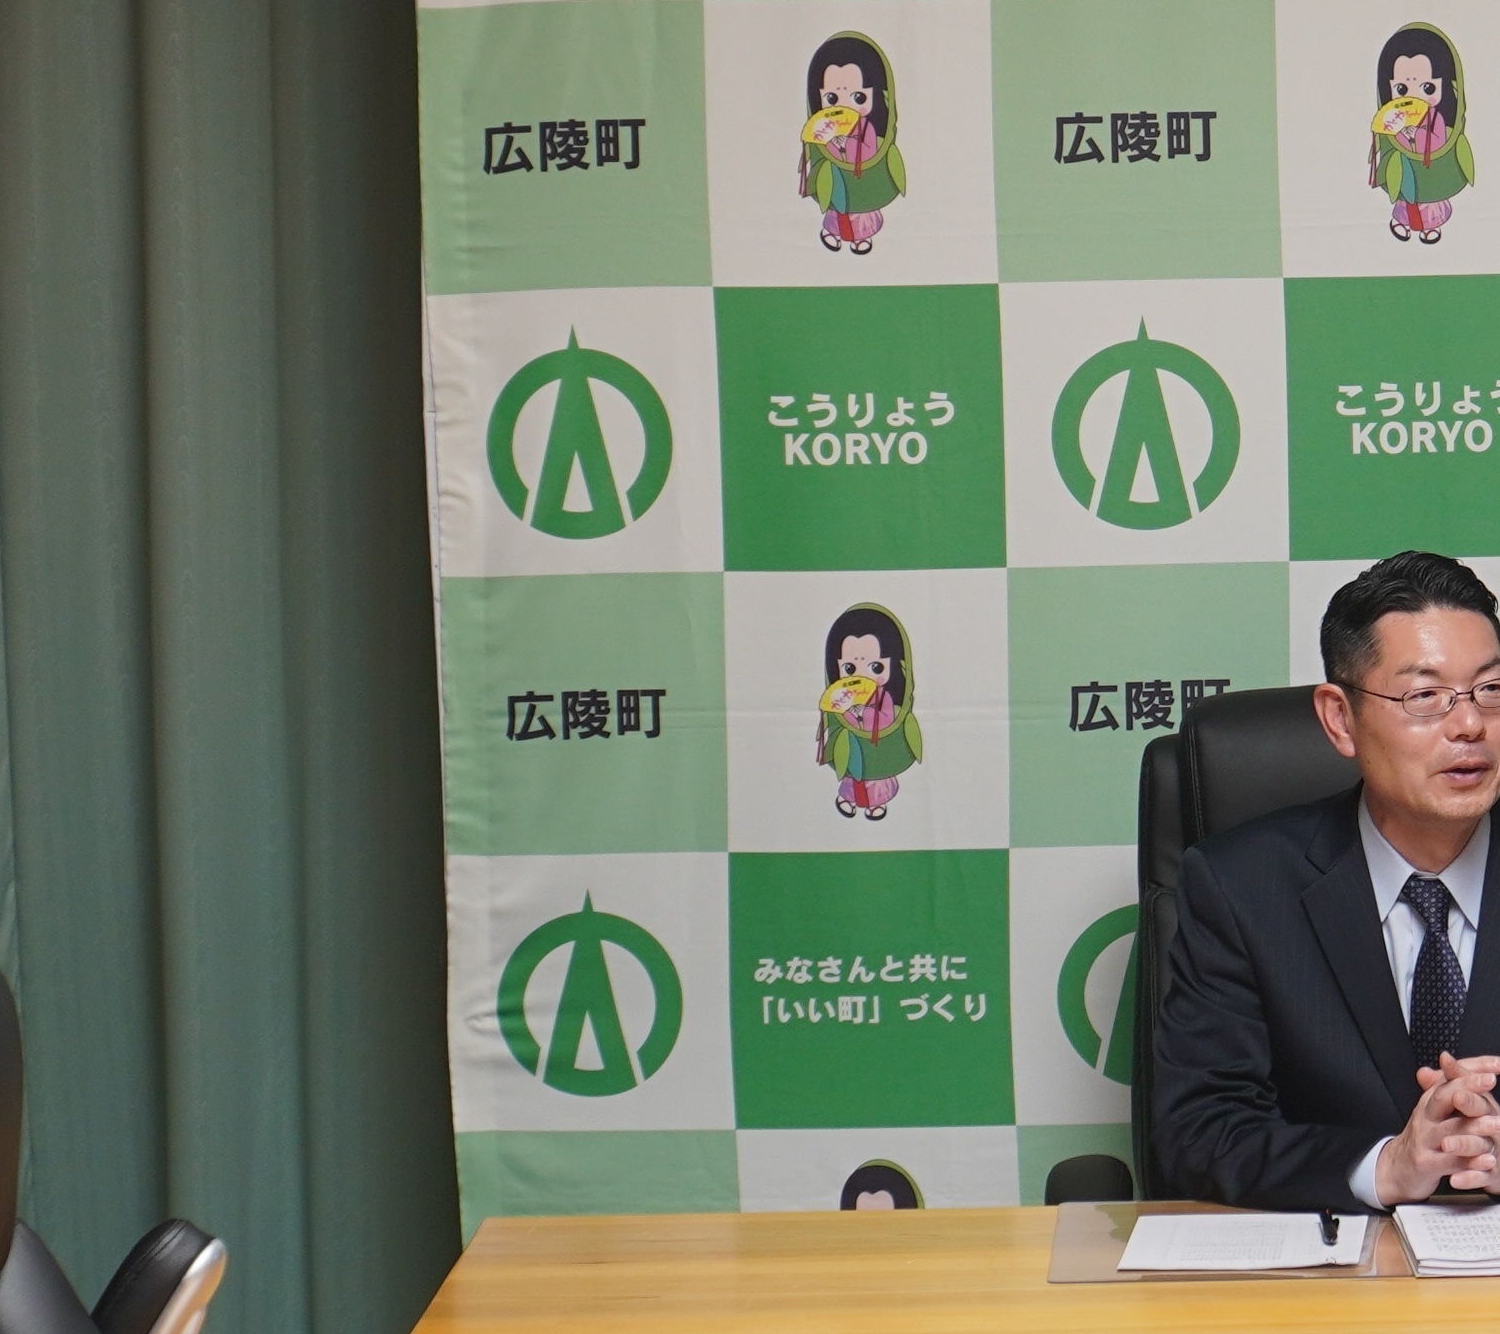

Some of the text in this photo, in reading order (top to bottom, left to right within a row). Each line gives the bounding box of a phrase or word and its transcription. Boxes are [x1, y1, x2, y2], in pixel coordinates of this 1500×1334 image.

[483, 118, 646, 175] 広陵町
[1053, 110, 1217, 164] 広陵町
[768, 391, 955, 428] こうりょう
[784, 431, 928, 466] KORYO
[1351, 418, 1493, 455] KORYO
[506, 688, 667, 742] 広陵町
[753, 953, 968, 985] みなさんと共に
